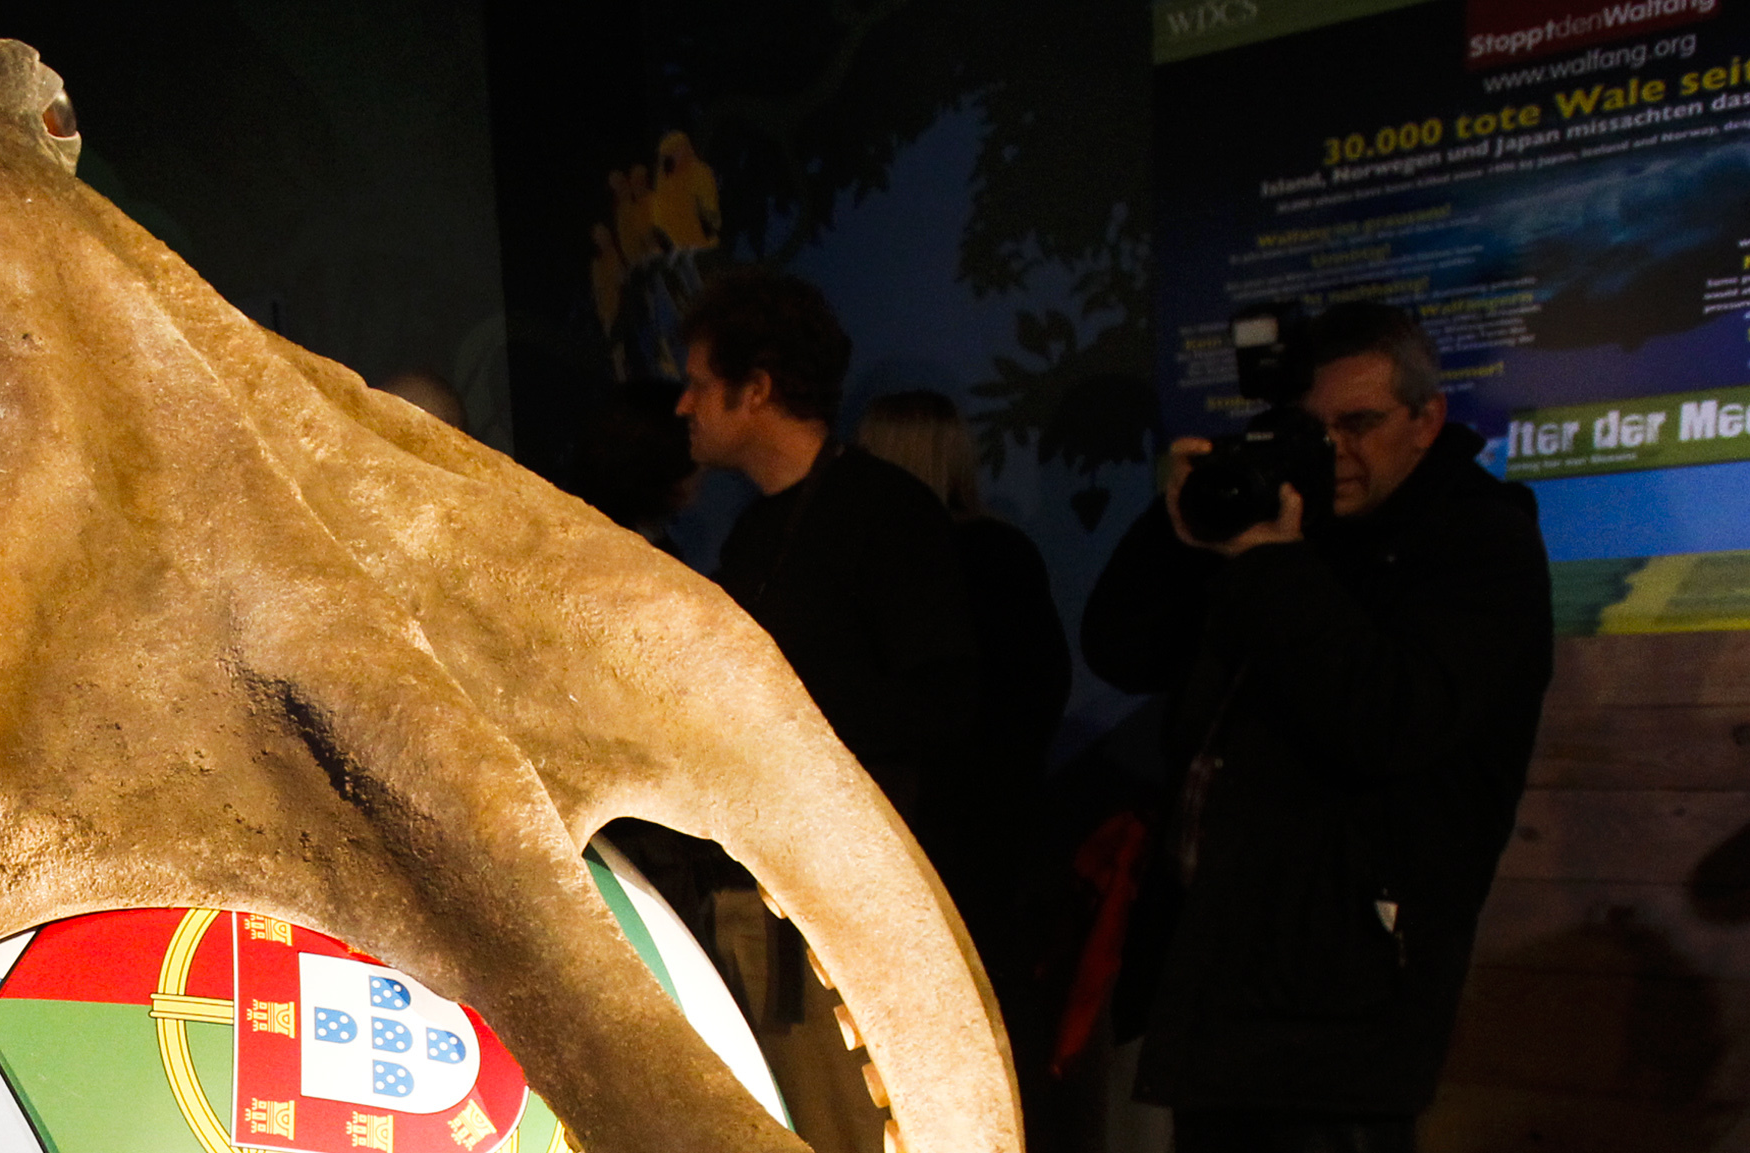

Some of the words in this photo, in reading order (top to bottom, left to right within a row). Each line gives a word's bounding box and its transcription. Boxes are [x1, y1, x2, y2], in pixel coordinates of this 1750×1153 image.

[1467, 0, 1717, 58] StopptdenWalfang
[1482, 33, 1697, 94] www.walfang.org
[1323, 117, 1443, 167] 30.000
[1456, 104, 1541, 139] tote
[1555, 77, 1666, 119] Wale
[1331, 151, 1443, 184] Norwegen
[1447, 139, 1490, 163] und
[1495, 128, 1561, 158] Japan
[1566, 101, 1704, 140] missachten
[1592, 408, 1667, 449] der
